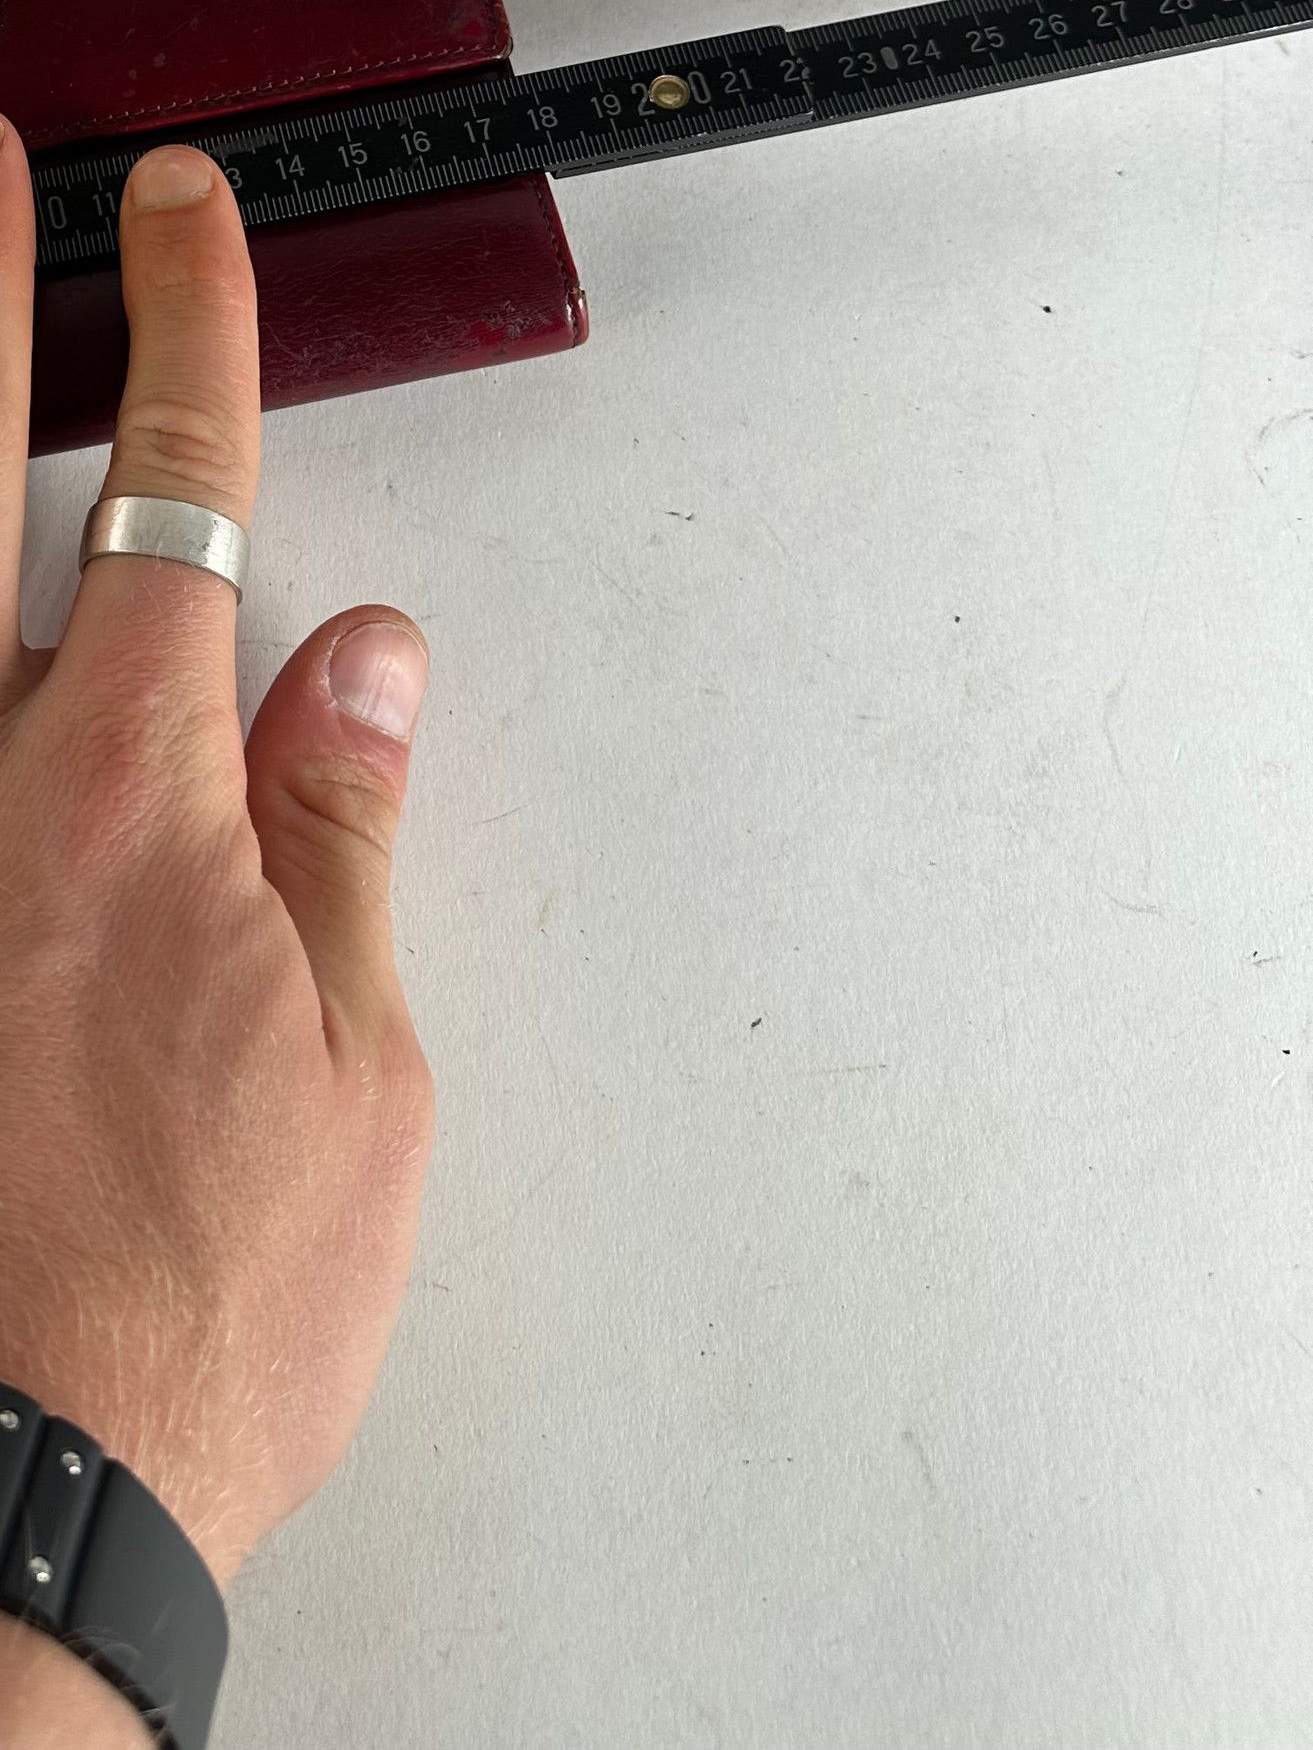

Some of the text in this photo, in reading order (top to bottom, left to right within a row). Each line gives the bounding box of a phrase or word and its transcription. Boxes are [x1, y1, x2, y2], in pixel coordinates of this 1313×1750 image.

[275, 154, 305, 181] 14
[337, 142, 368, 169] 15
[400, 130, 431, 156] 16
[463, 117, 491, 144] 17
[526, 105, 558, 131] 18
[590, 93, 622, 119] 19
[719, 67, 753, 94] 21
[838, 51, 878, 79] 23
[902, 38, 942, 67] 24
[965, 25, 1005, 54] 25
[1028, 13, 1068, 41] 26
[1091, 0, 1128, 28] 27
